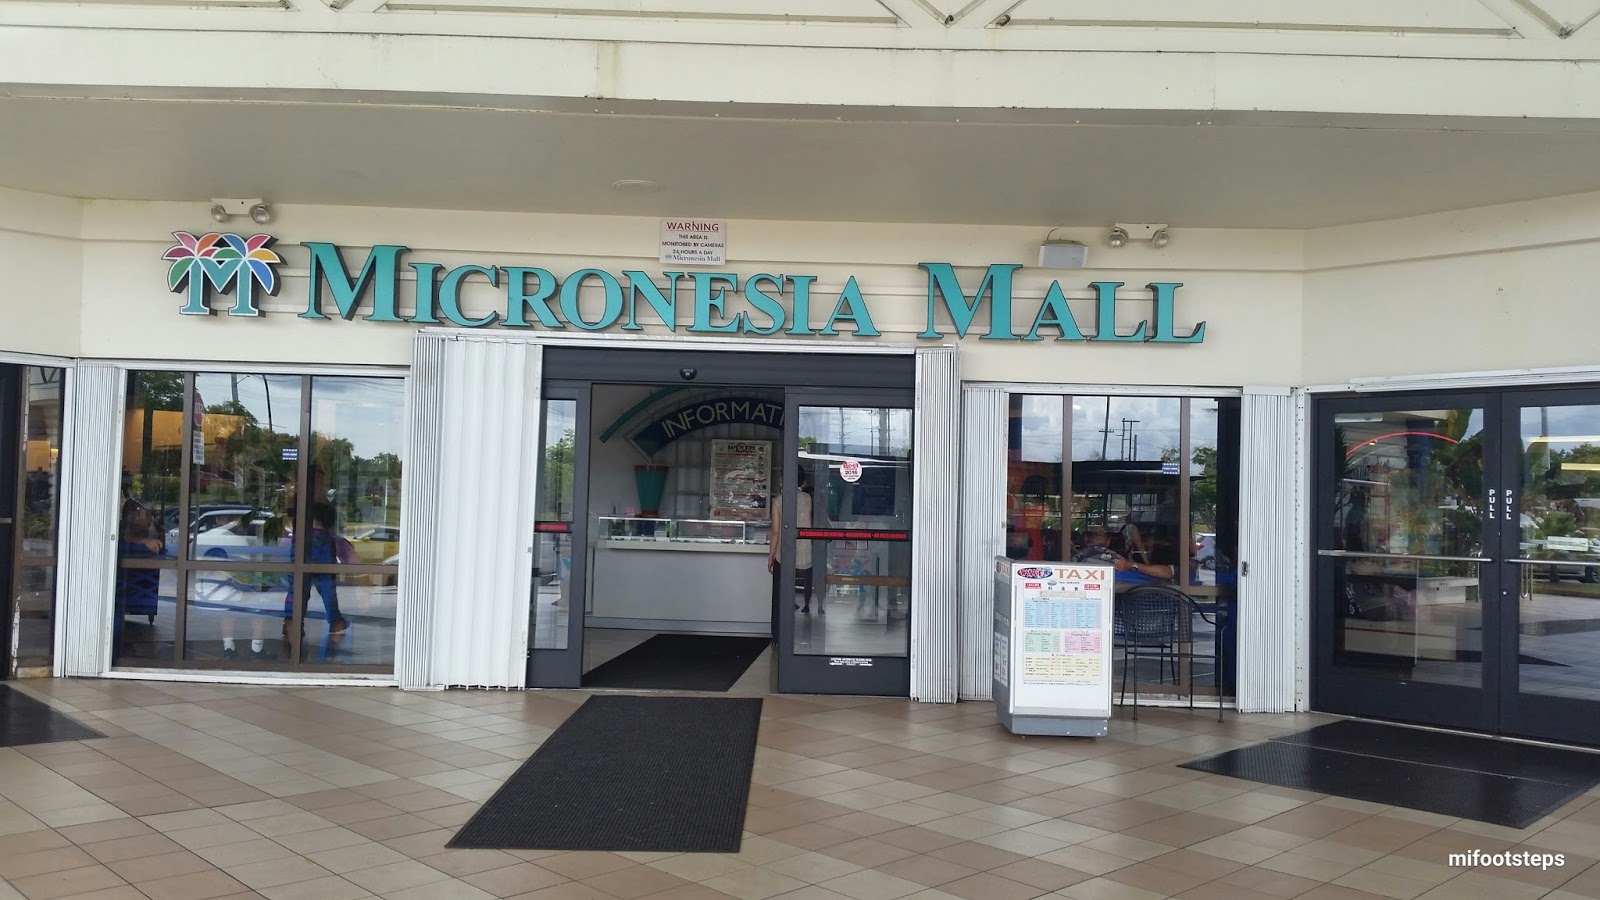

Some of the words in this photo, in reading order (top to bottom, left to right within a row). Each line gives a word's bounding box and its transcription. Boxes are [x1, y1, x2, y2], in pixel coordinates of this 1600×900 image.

[666, 221, 719, 231] WARNING
[297, 241, 881, 337] MICRONESIA
[916, 262, 1206, 344] MALL
[1055, 568, 1105, 581] TAXI
